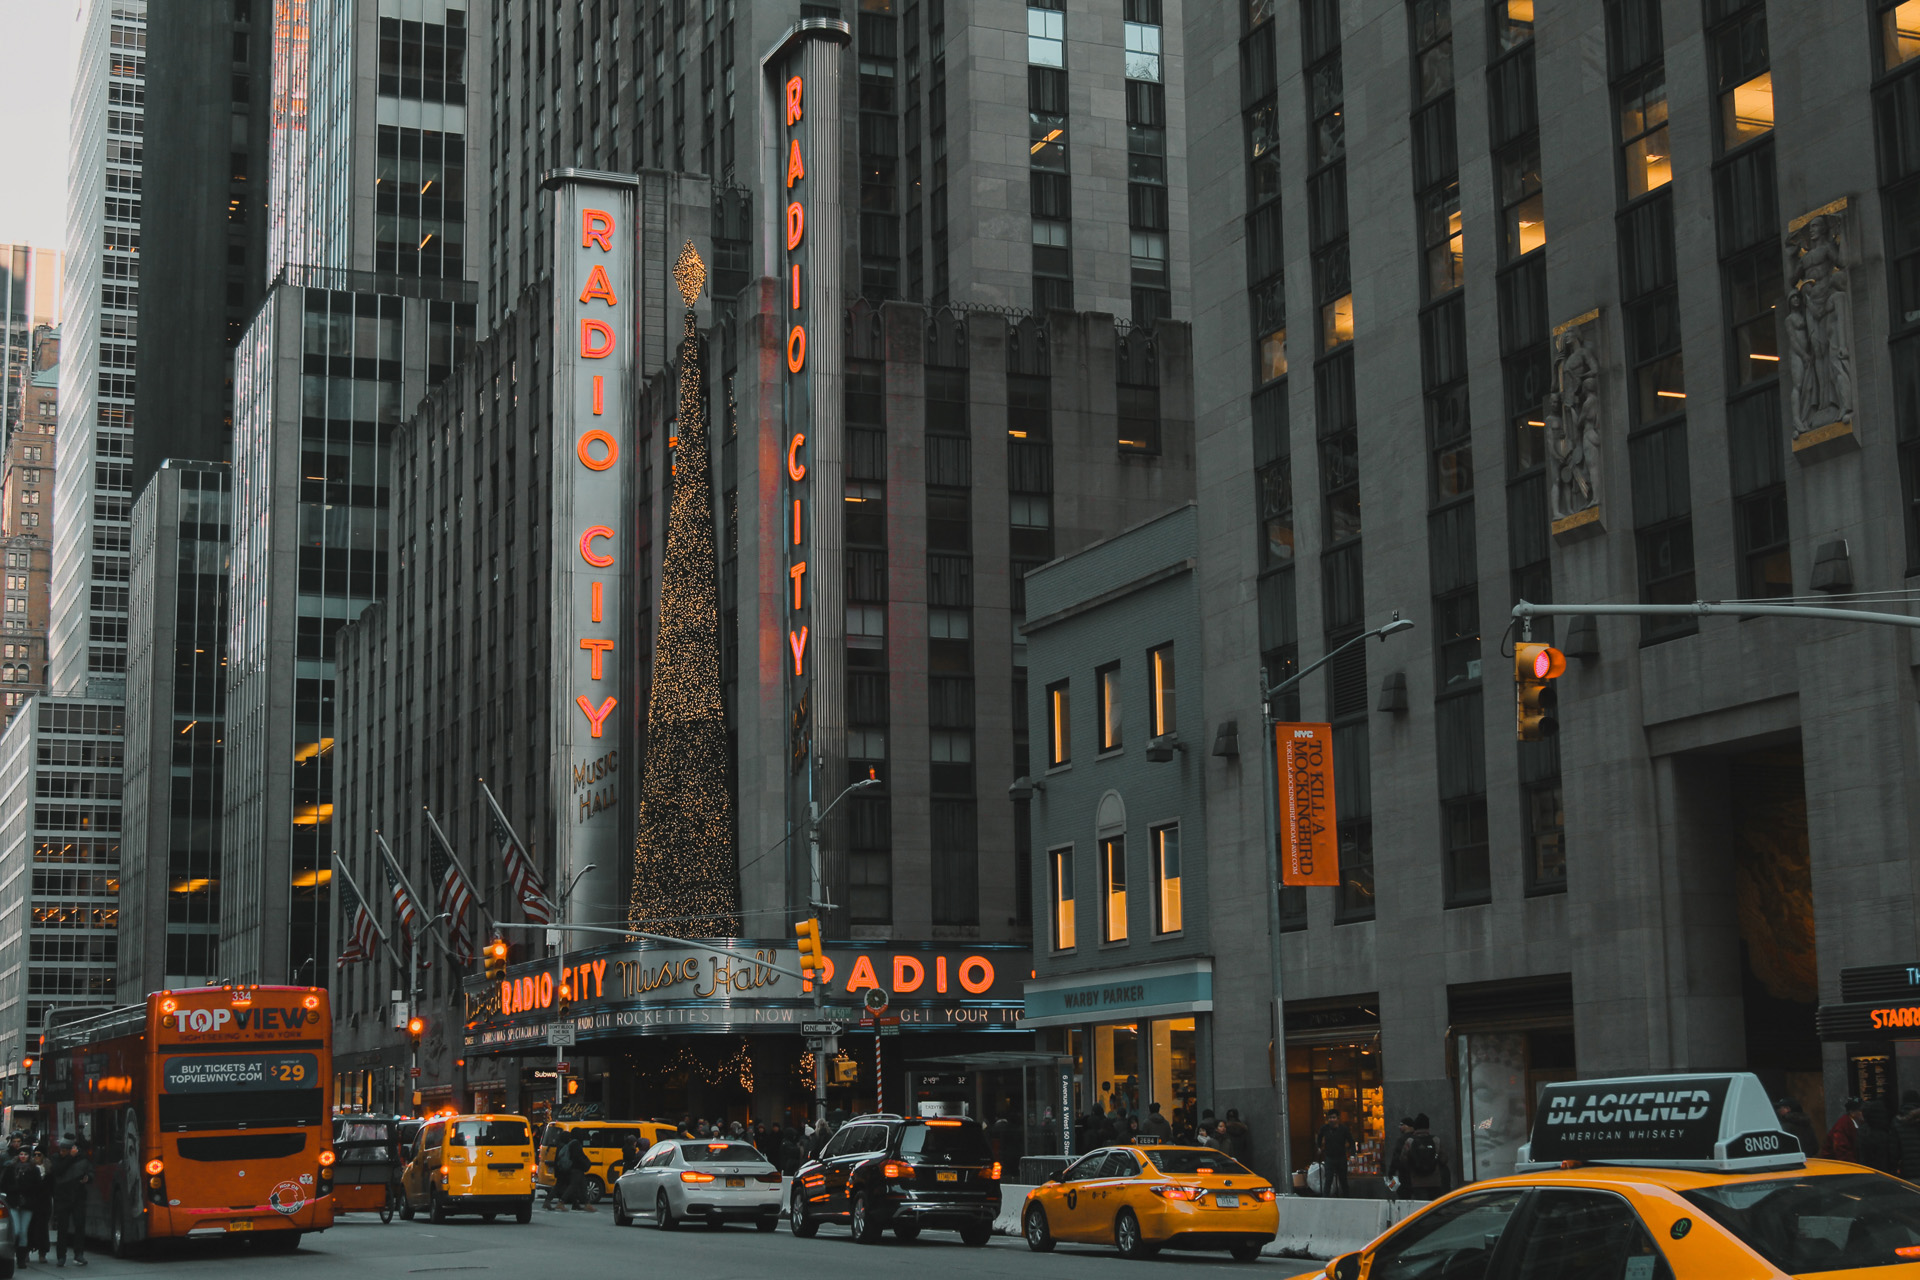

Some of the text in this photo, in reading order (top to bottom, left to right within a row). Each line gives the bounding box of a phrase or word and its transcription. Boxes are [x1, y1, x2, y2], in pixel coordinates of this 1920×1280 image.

[787, 76, 806, 373] RADIO
[576, 208, 618, 738] RADIO CITY
[788, 433, 808, 676] CITY
[1294, 730, 1313, 738] NYC
[573, 750, 618, 794] MUSIC
[1309, 740, 1325, 835] TO KILL A
[579, 783, 618, 824] HALL
[1294, 740, 1314, 876] MOCKINGBIRD
[501, 971, 553, 1016] RADIO
[614, 957, 700, 998] Music
[693, 949, 781, 997] Hall
[232, 991, 251, 1001] 334
[1064, 985, 1145, 1009] WARBY PARKER
[577, 1015, 594, 1031] RADIO
[595, 1013, 611, 1028] CITY
[616, 1008, 710, 1025] ROCKETTES
[755, 1008, 793, 1022] NOW
[900, 1008, 930, 1022] GET
[945, 1008, 988, 1023] YOUR
[804, 1024, 838, 1032] ONE WAY
[1870, 1006, 1920, 1029] STARR
[178, 1030, 302, 1042] SIGHTSEEING NEW YORK
[170, 1072, 262, 1084] TOPVIEWNYC.COM
[181, 1062, 262, 1074] BUY TICKETS AT
[534, 1070, 558, 1079] Subway
[1546, 1089, 1710, 1125] BLACKENED
[1139, 1136, 1155, 1144] 2E84
[1561, 1129, 1685, 1142] AMERICAN WHISKEY
[1744, 1135, 1779, 1152] 8N80
